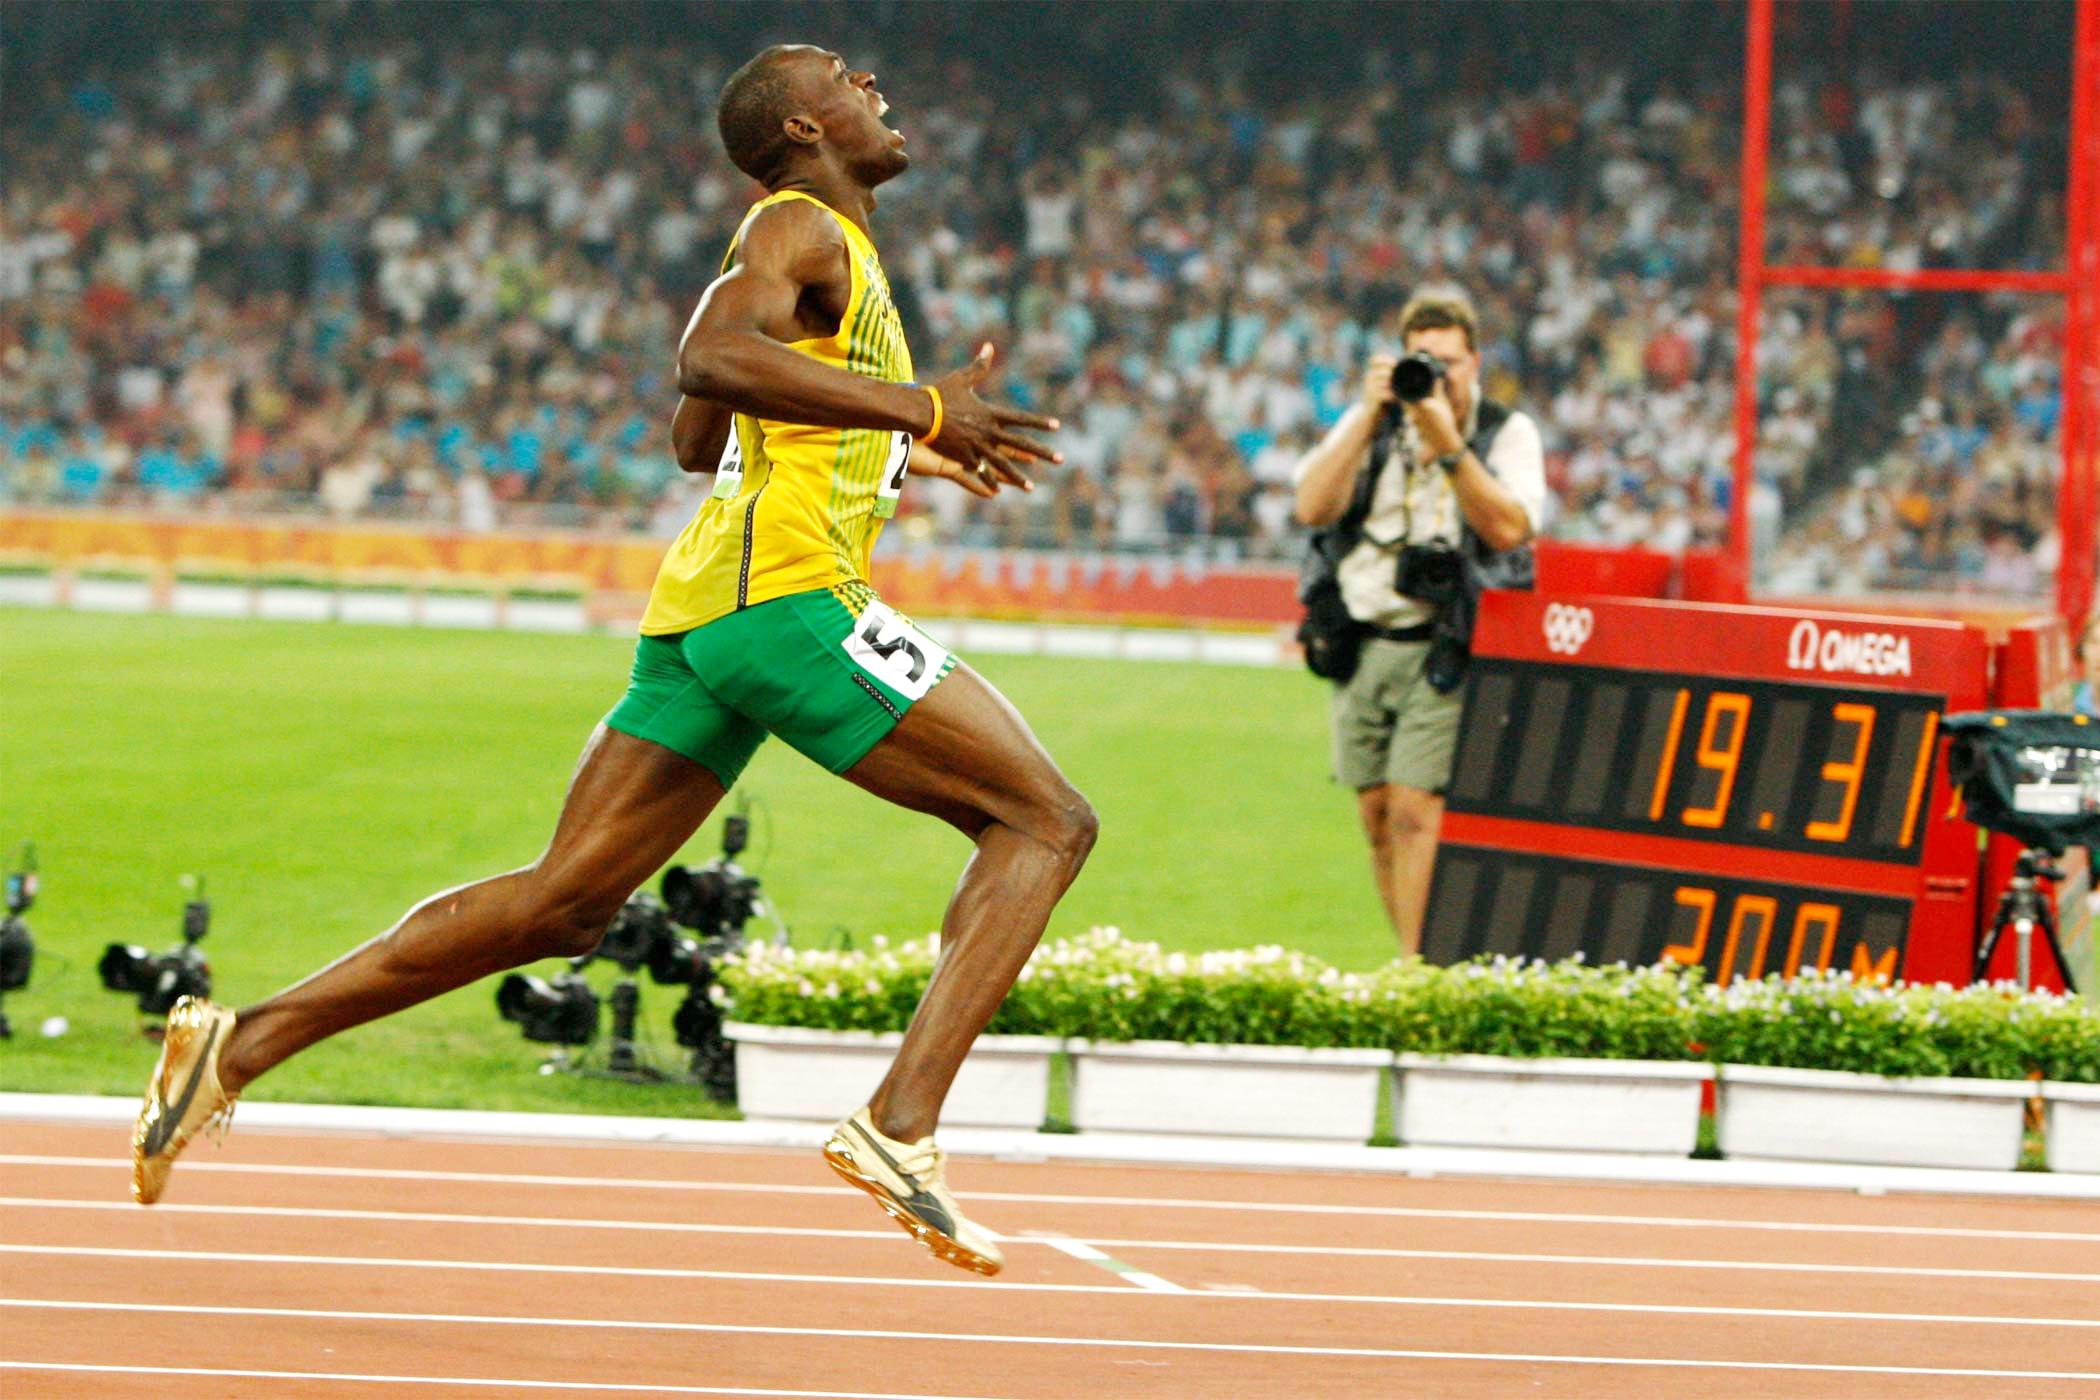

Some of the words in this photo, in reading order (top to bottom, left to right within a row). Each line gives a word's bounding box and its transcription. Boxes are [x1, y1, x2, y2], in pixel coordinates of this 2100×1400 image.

[861, 615, 926, 684] 5
[1821, 629, 1912, 677] OMEGA
[1649, 688, 1940, 849] 19.31
